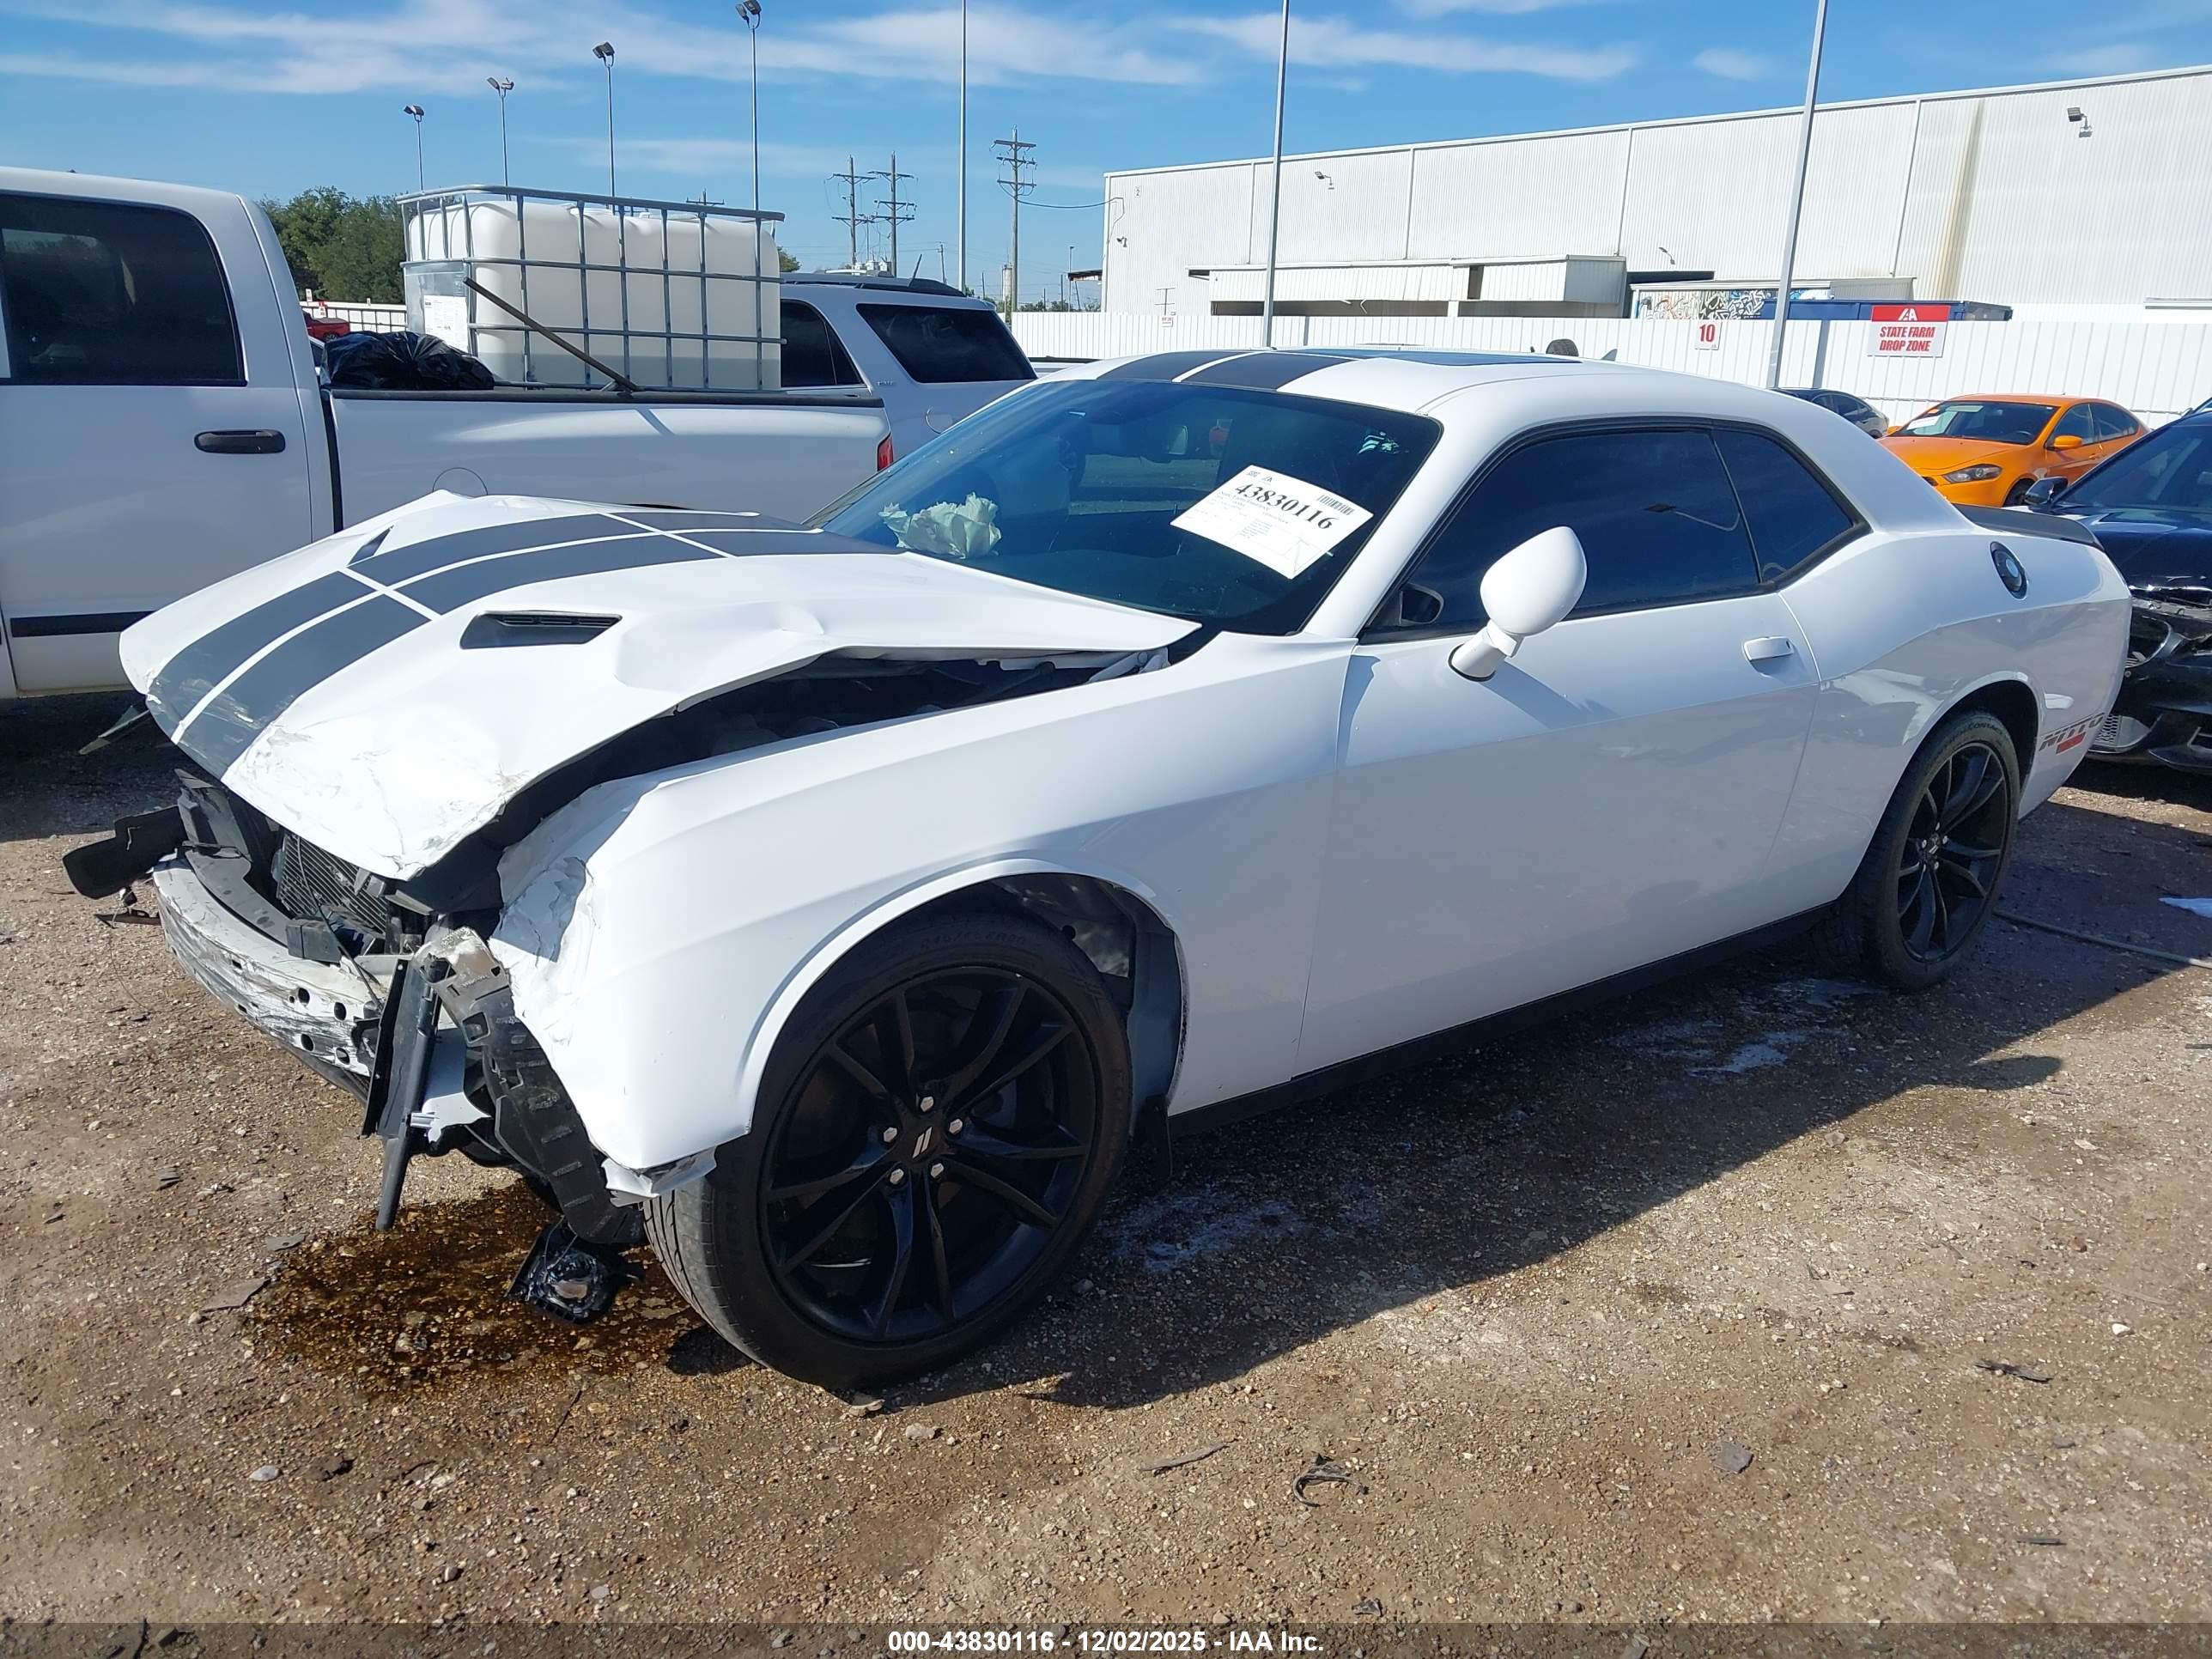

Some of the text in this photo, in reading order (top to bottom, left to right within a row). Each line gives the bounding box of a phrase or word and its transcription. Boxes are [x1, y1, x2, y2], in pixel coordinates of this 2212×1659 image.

[1699, 324, 1716, 343] 10
[1879, 326, 1936, 338] STATE FARM
[1879, 340, 1931, 352] DROP ZONE
[1235, 483, 1340, 530] 43830116
